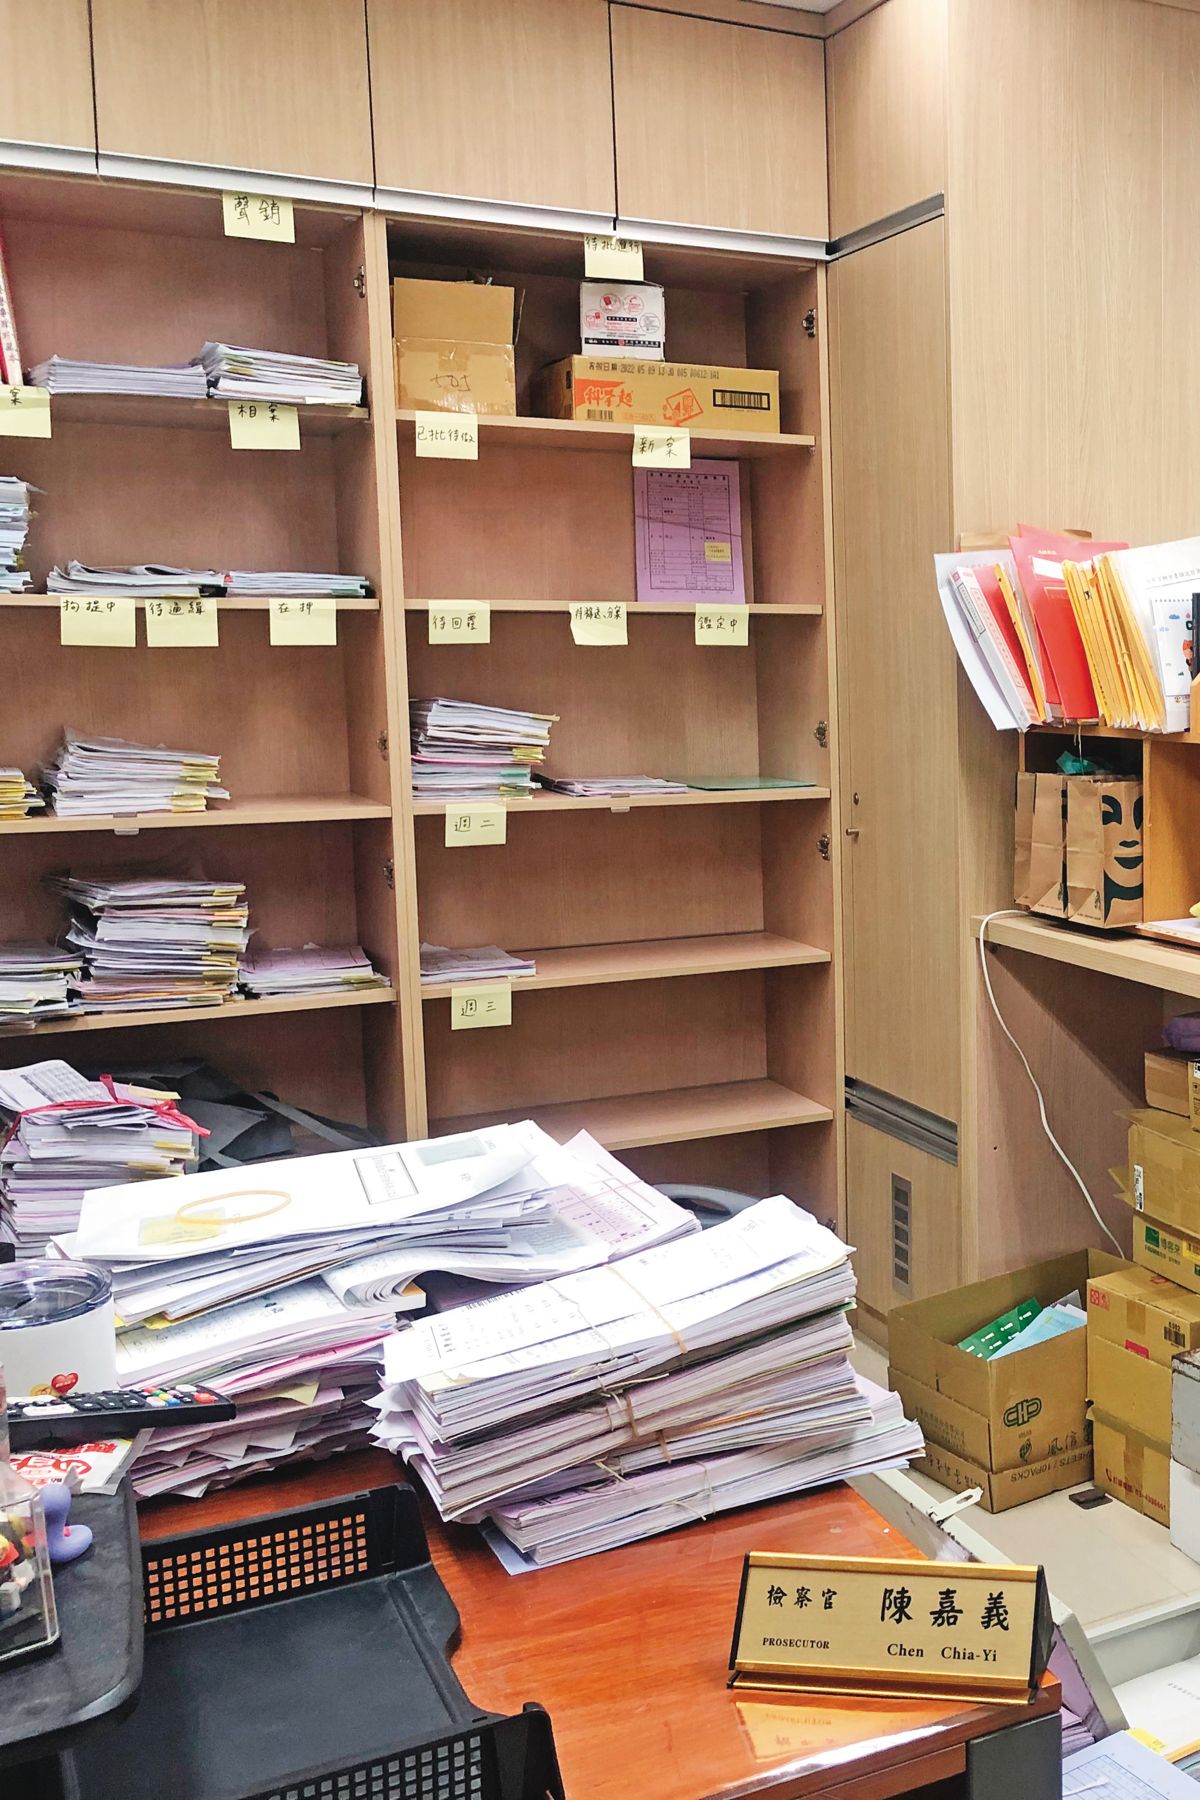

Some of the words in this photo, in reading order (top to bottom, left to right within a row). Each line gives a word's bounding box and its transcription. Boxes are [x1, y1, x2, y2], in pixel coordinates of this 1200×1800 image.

[237, 402, 280, 423] 相案
[431, 611, 480, 632] 待回覆
[453, 815, 495, 833] 週二
[461, 998, 497, 1017] 週三
[766, 1584, 839, 1611] 檢察官
[880, 1587, 1010, 1632] 陳嘉義
[762, 1637, 831, 1650] PROSECUTOR
[886, 1643, 925, 1658] Chen
[940, 1645, 998, 1663] Chia-Yi
